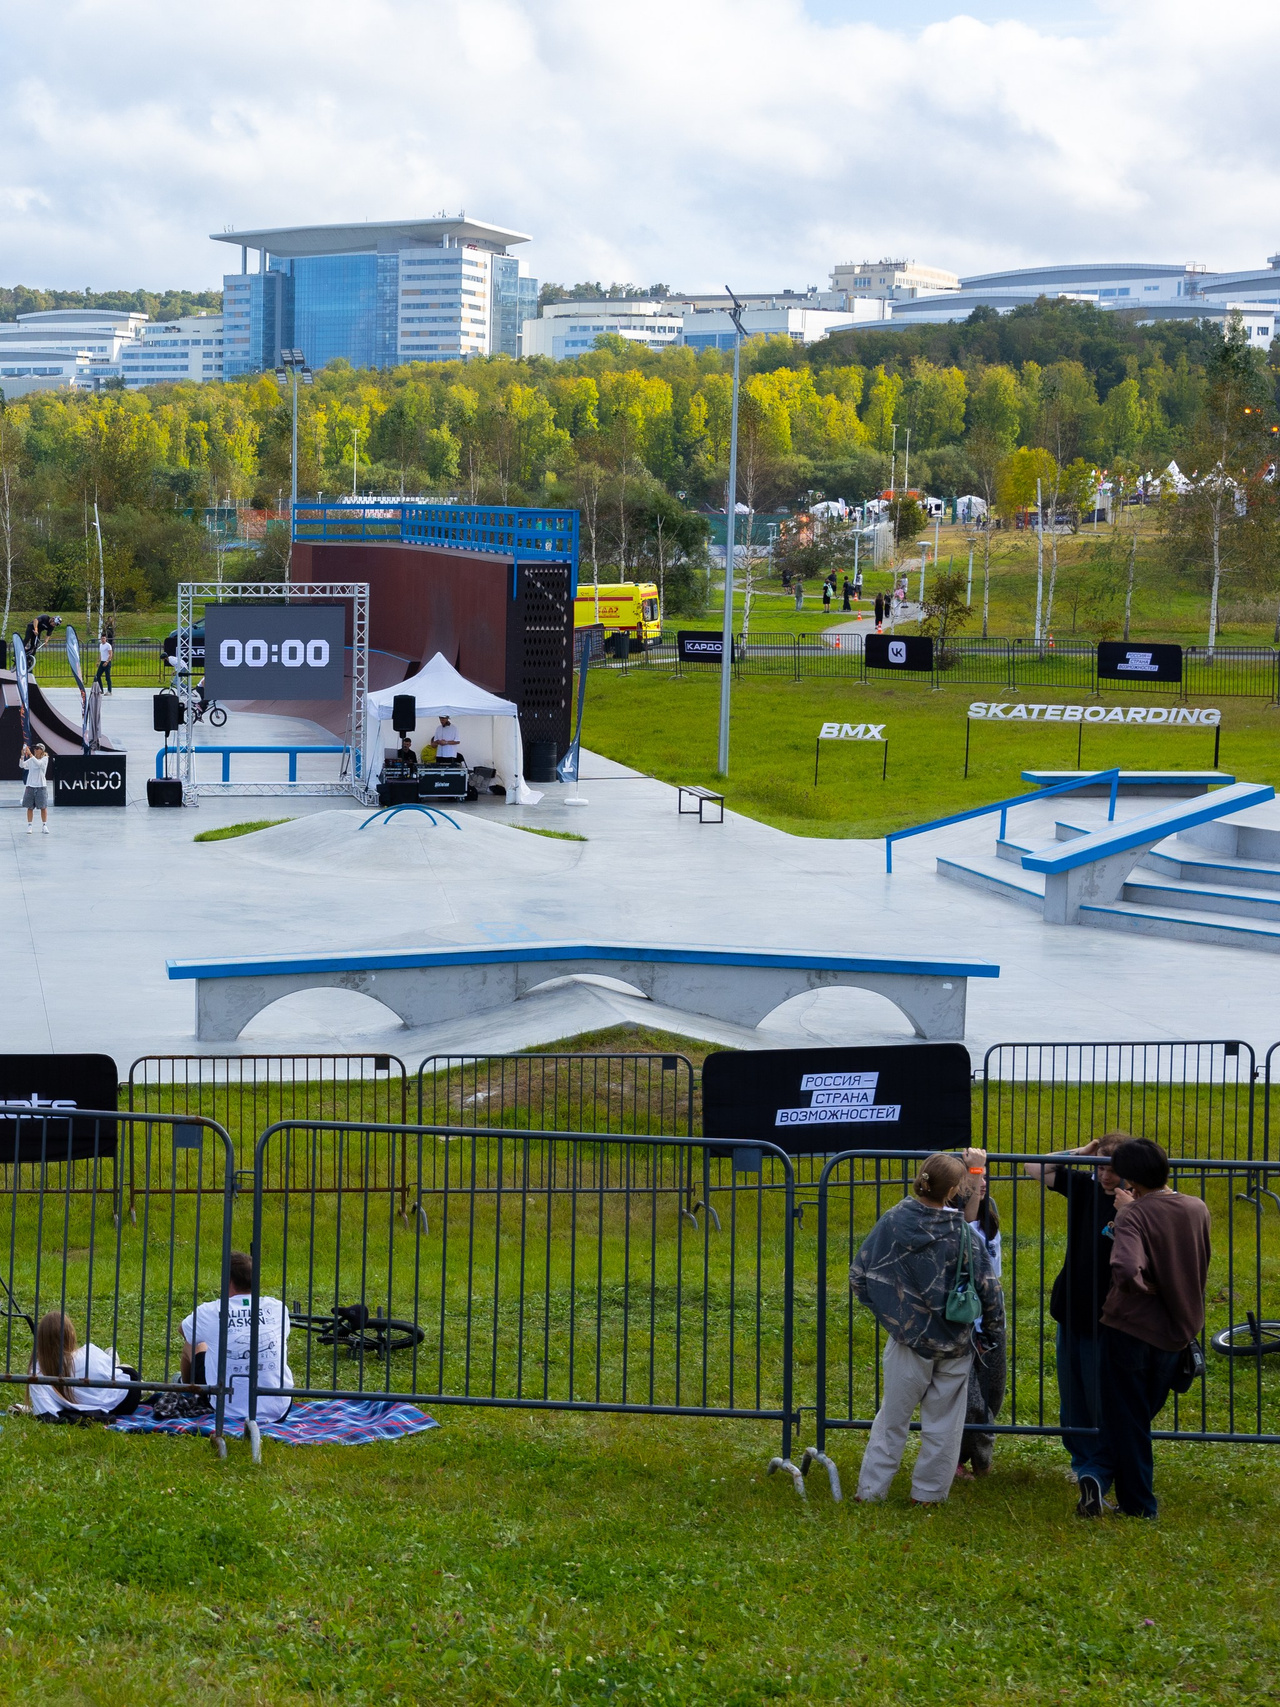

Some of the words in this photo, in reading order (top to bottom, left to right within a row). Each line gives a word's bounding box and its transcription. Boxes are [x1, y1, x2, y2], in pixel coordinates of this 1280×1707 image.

[219, 639, 330, 667] 00:00
[686, 643, 722, 651] КАРДО
[891, 647, 903, 658] VK
[967, 702, 1221, 725] SKATEBOARDING
[819, 722, 887, 740] BMX
[805, 1075, 862, 1087] РОССИЯ
[815, 1092, 869, 1104] СТРАНА
[780, 1106, 896, 1122] ВОЗМОЖНОСТЕЙ
